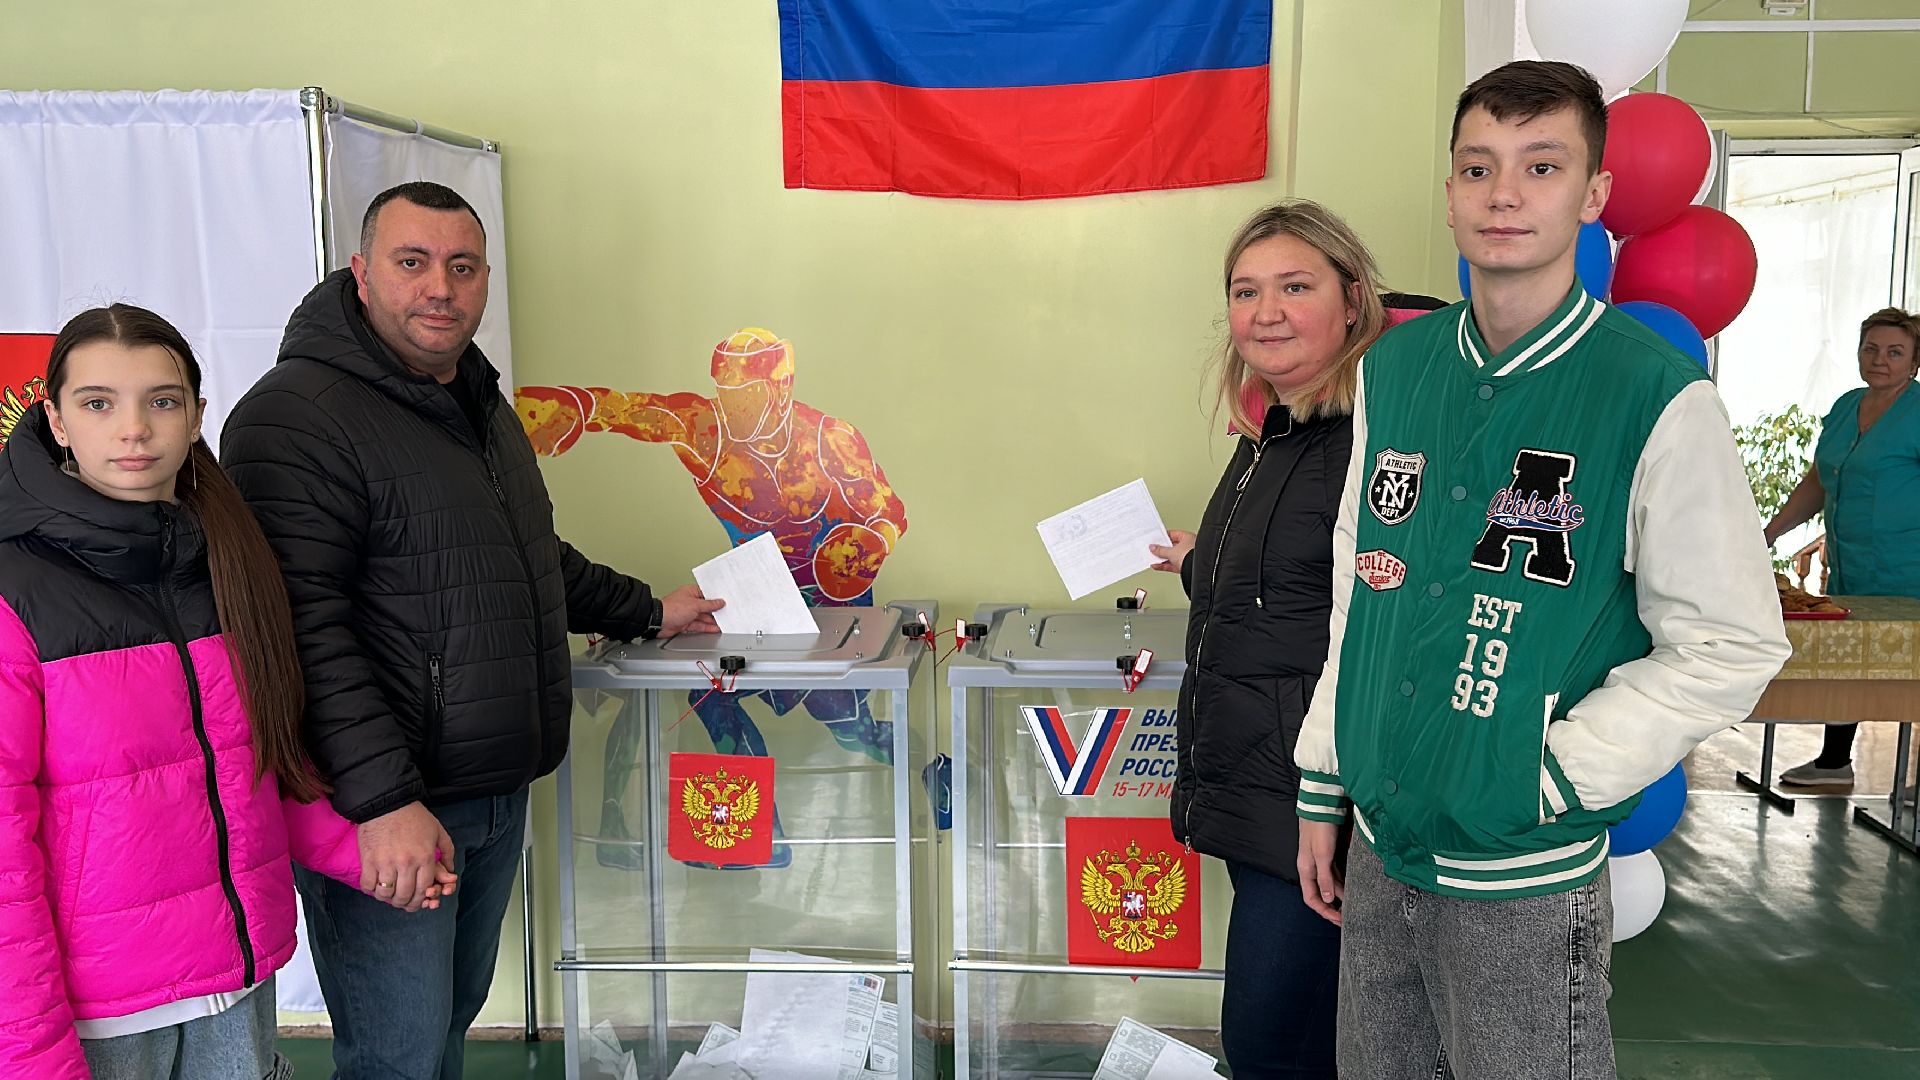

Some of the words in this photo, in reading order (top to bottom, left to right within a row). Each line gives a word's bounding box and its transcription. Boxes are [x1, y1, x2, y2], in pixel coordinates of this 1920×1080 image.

[1385, 458, 1418, 470] ATHLETIC
[1381, 506, 1400, 518] DEPT.
[1486, 488, 1583, 524] Athletic
[1357, 555, 1405, 582] COLLEGE
[1467, 593, 1522, 633] EST
[1458, 633, 1509, 679] 19
[1451, 673, 1499, 718] 93
[1140, 708, 1178, 727] ВЫ
[1119, 757, 1179, 778] РОСС
[1154, 782, 1173, 799] М
